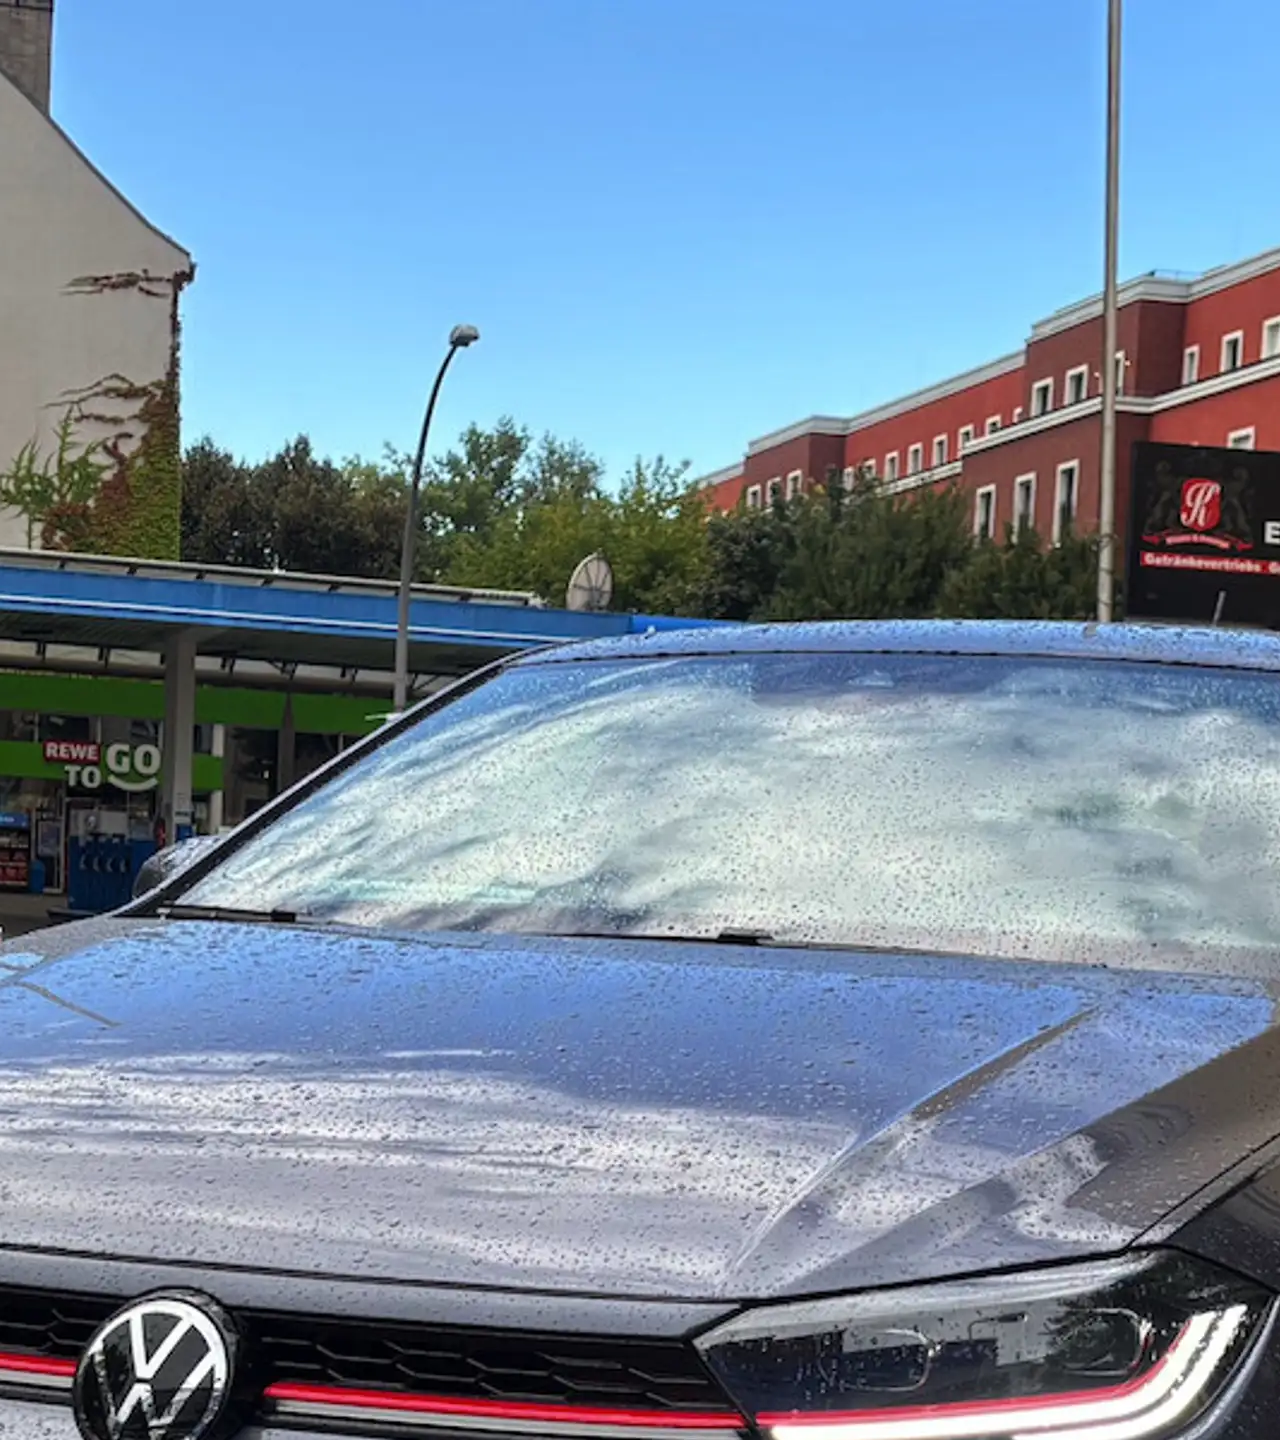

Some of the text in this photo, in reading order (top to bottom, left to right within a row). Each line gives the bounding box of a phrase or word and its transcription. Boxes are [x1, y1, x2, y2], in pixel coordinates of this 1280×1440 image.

[45, 742, 99, 761] REWE
[64, 743, 161, 788] TO GO
